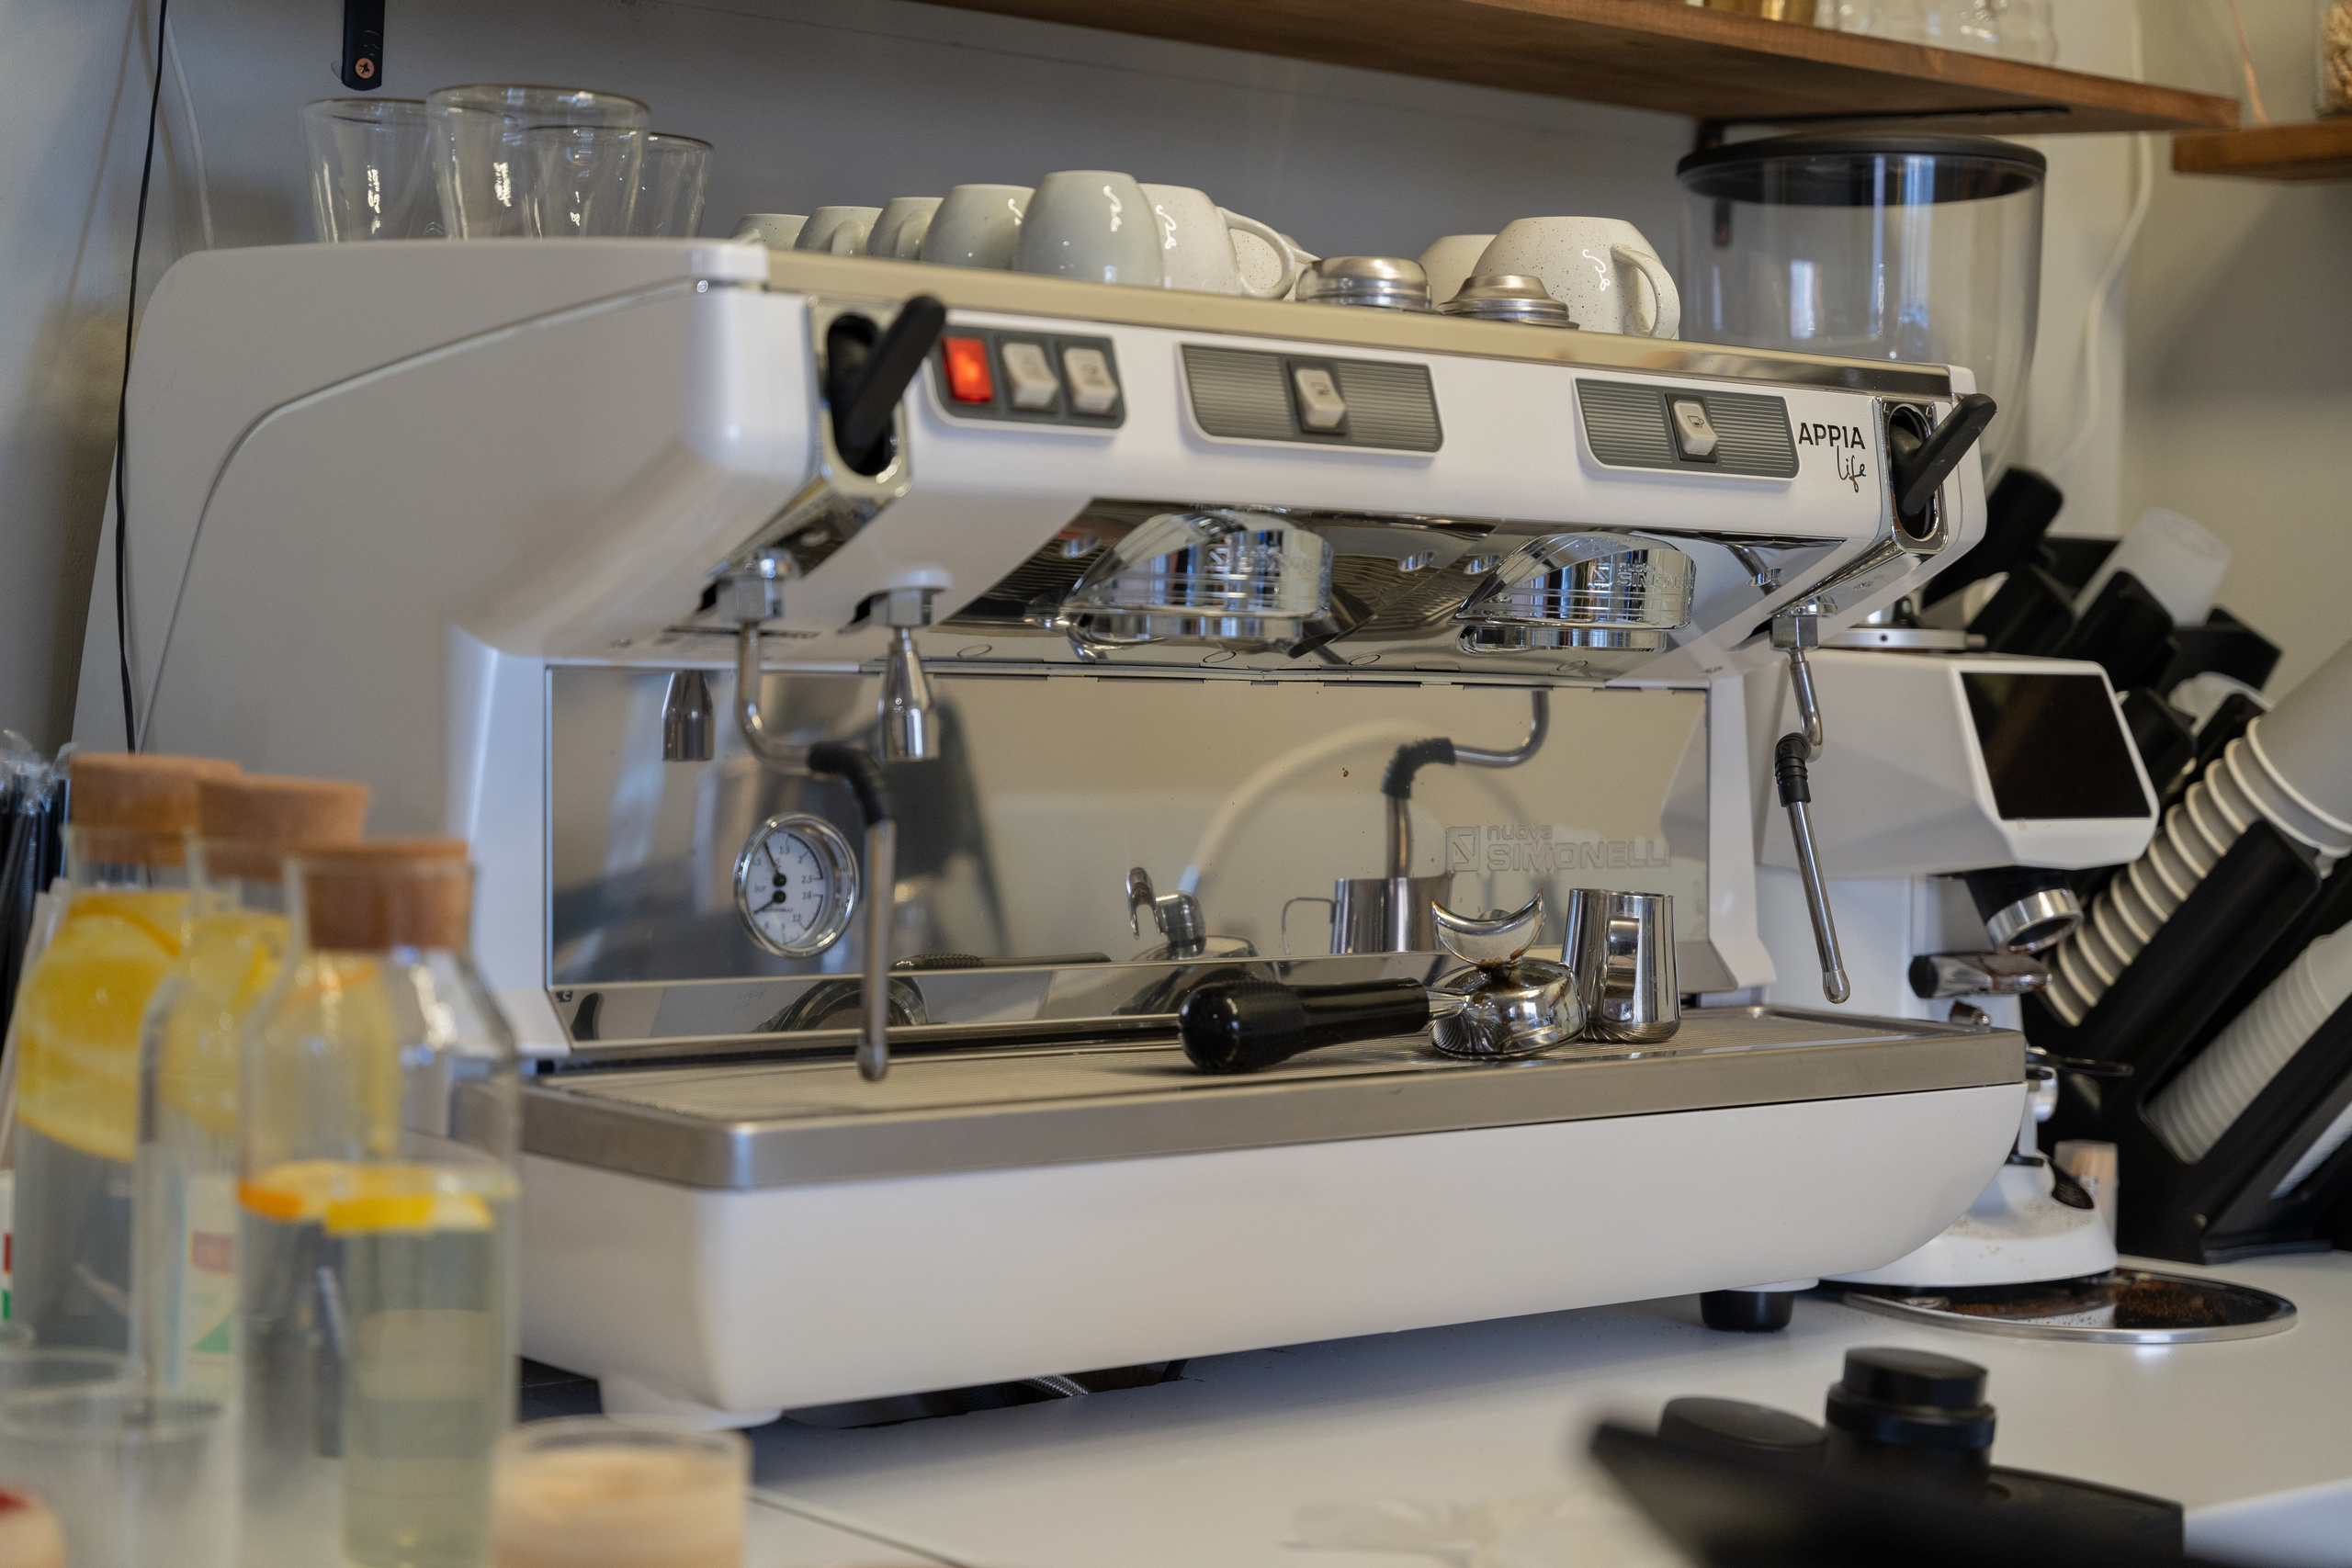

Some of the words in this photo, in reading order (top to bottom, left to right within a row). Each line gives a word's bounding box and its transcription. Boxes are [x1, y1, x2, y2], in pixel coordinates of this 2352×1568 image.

[1798, 422, 1865, 450] APPIA
[1487, 825, 1553, 840] nuova
[1487, 840, 1671, 872] SIMONELLI
[800, 875, 812, 884] 2.5
